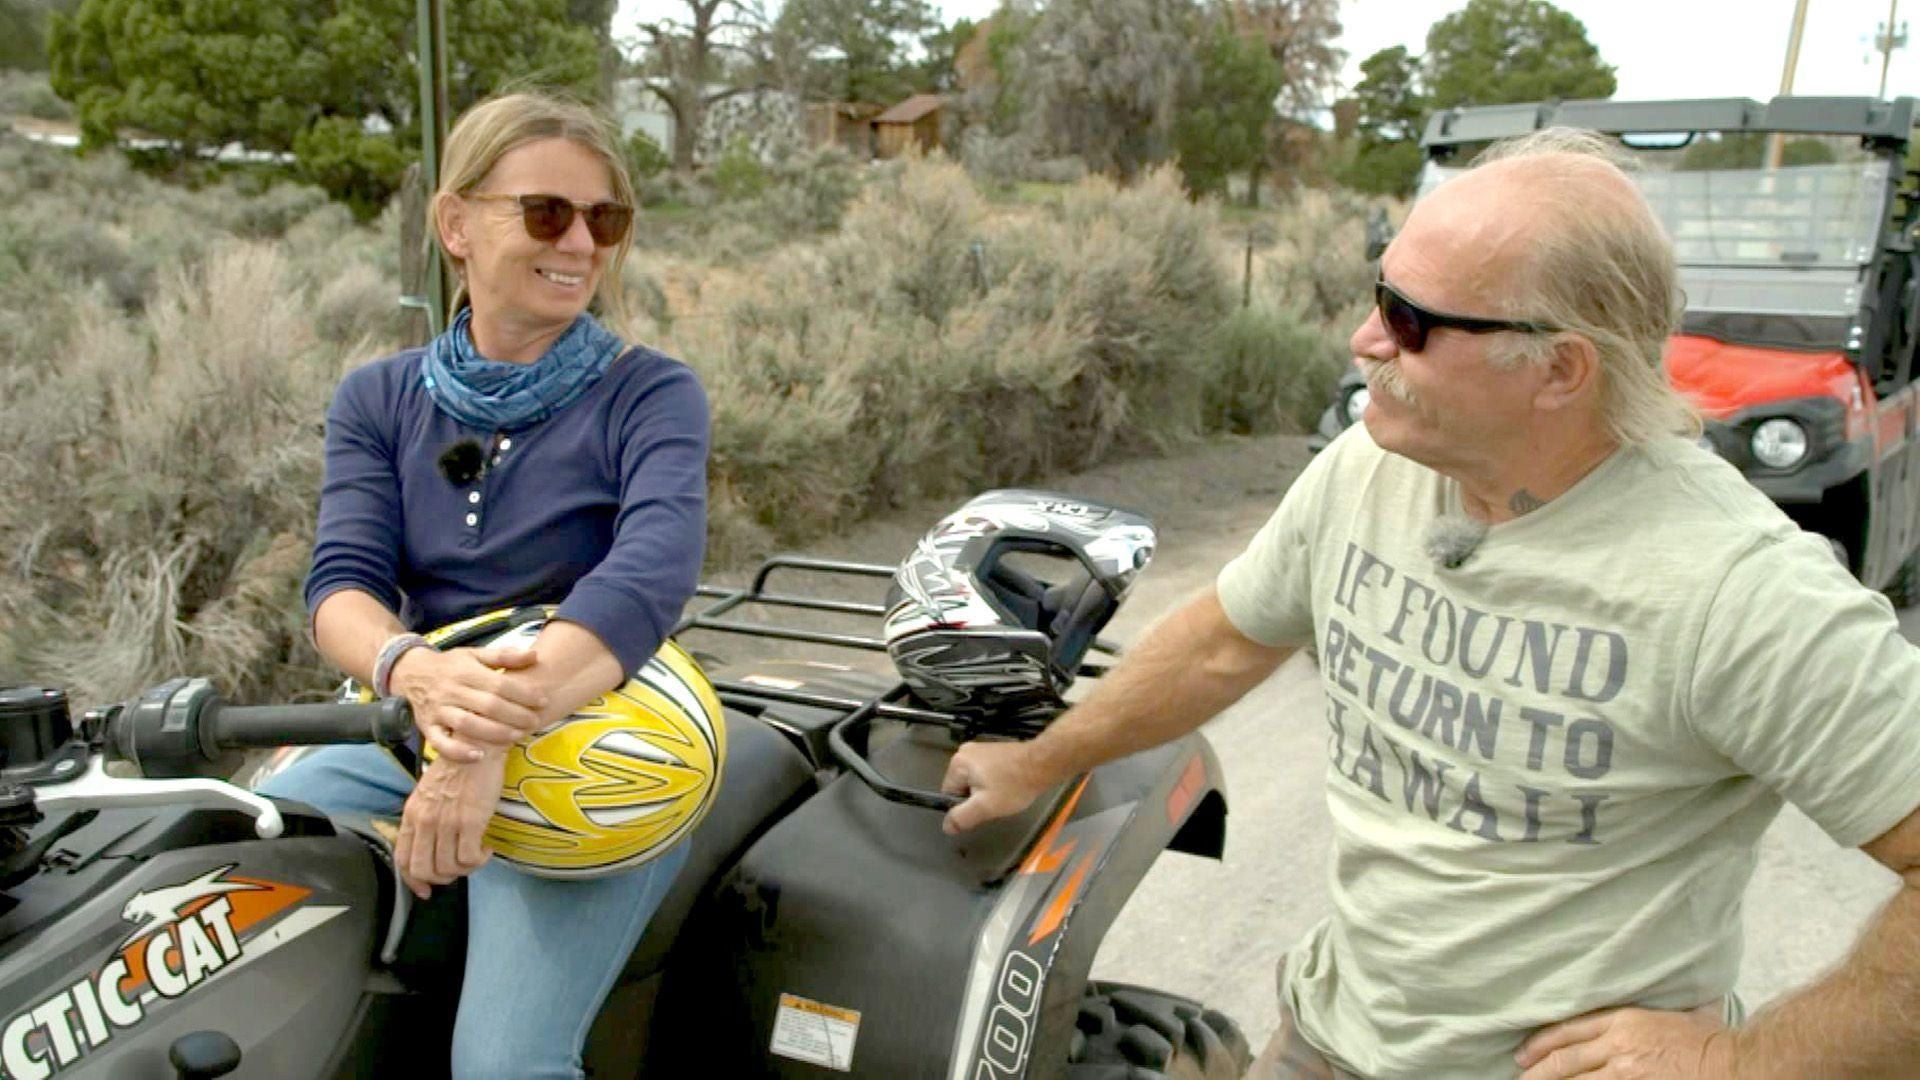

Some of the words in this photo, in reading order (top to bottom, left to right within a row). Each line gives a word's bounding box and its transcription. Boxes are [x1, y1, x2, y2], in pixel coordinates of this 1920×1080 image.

[1324, 617, 1503, 760] RETURN
[1519, 706, 1614, 780] TO
[1334, 542, 1394, 615] IF
[1384, 575, 1629, 703] FOUND
[0, 957, 144, 1080] CTIC
[145, 895, 243, 999] CAT
[975, 950, 1042, 1080] 00
